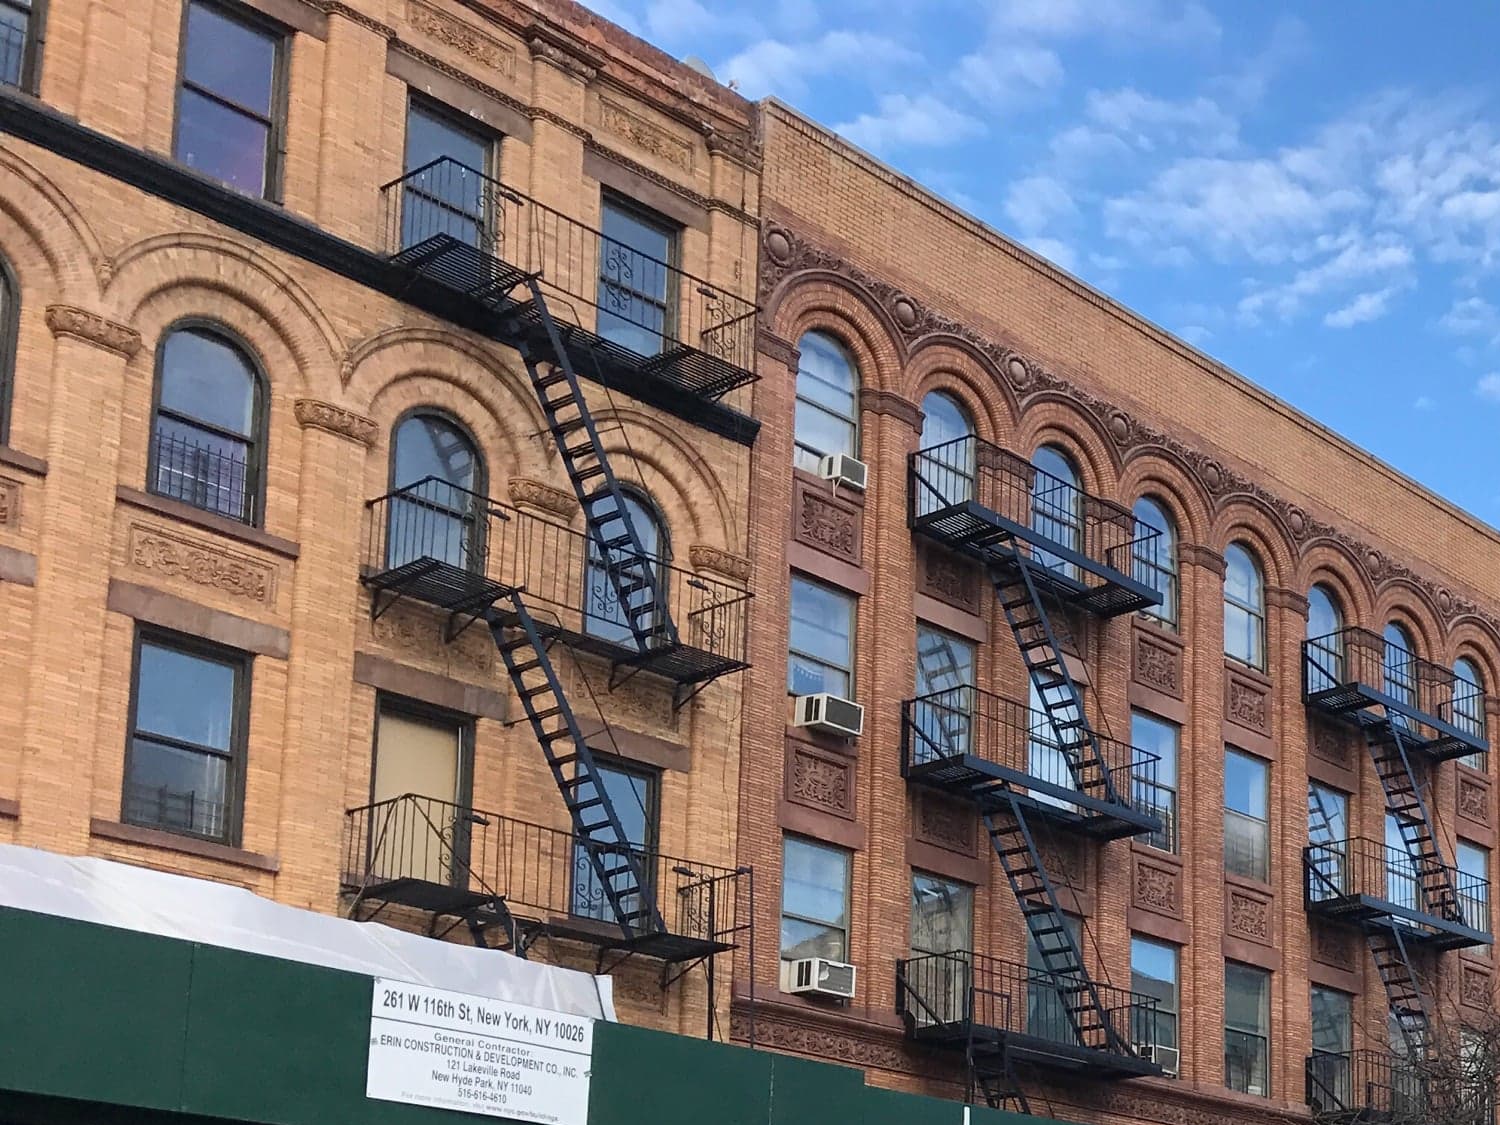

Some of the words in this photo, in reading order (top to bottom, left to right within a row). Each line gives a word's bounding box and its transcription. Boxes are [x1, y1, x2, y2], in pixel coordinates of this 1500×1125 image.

[383, 989, 404, 1009] 261
[408, 993, 420, 1013] W
[424, 996, 455, 1019] 116th
[458, 1003, 473, 1025] St,
[477, 1006, 501, 1027] New
[504, 1011, 532, 1035] York,
[535, 1017, 551, 1036] NY
[554, 1022, 585, 1043] 10026
[380, 1034, 402, 1046] ERIN
[404, 1038, 474, 1060] CONSTRUCTION
[475, 1050, 482, 1061] &
[484, 1051, 544, 1072] DEVELOPMENT
[434, 1032, 475, 1047] General
[432, 1069, 450, 1083] New
[452, 1073, 473, 1087] Hyde
[497, 1080, 509, 1091] NY
[511, 1083, 533, 1096] 11040
[447, 1060, 461, 1071] 121
[463, 1061, 499, 1078] Lakeville
[500, 1067, 521, 1081] Road
